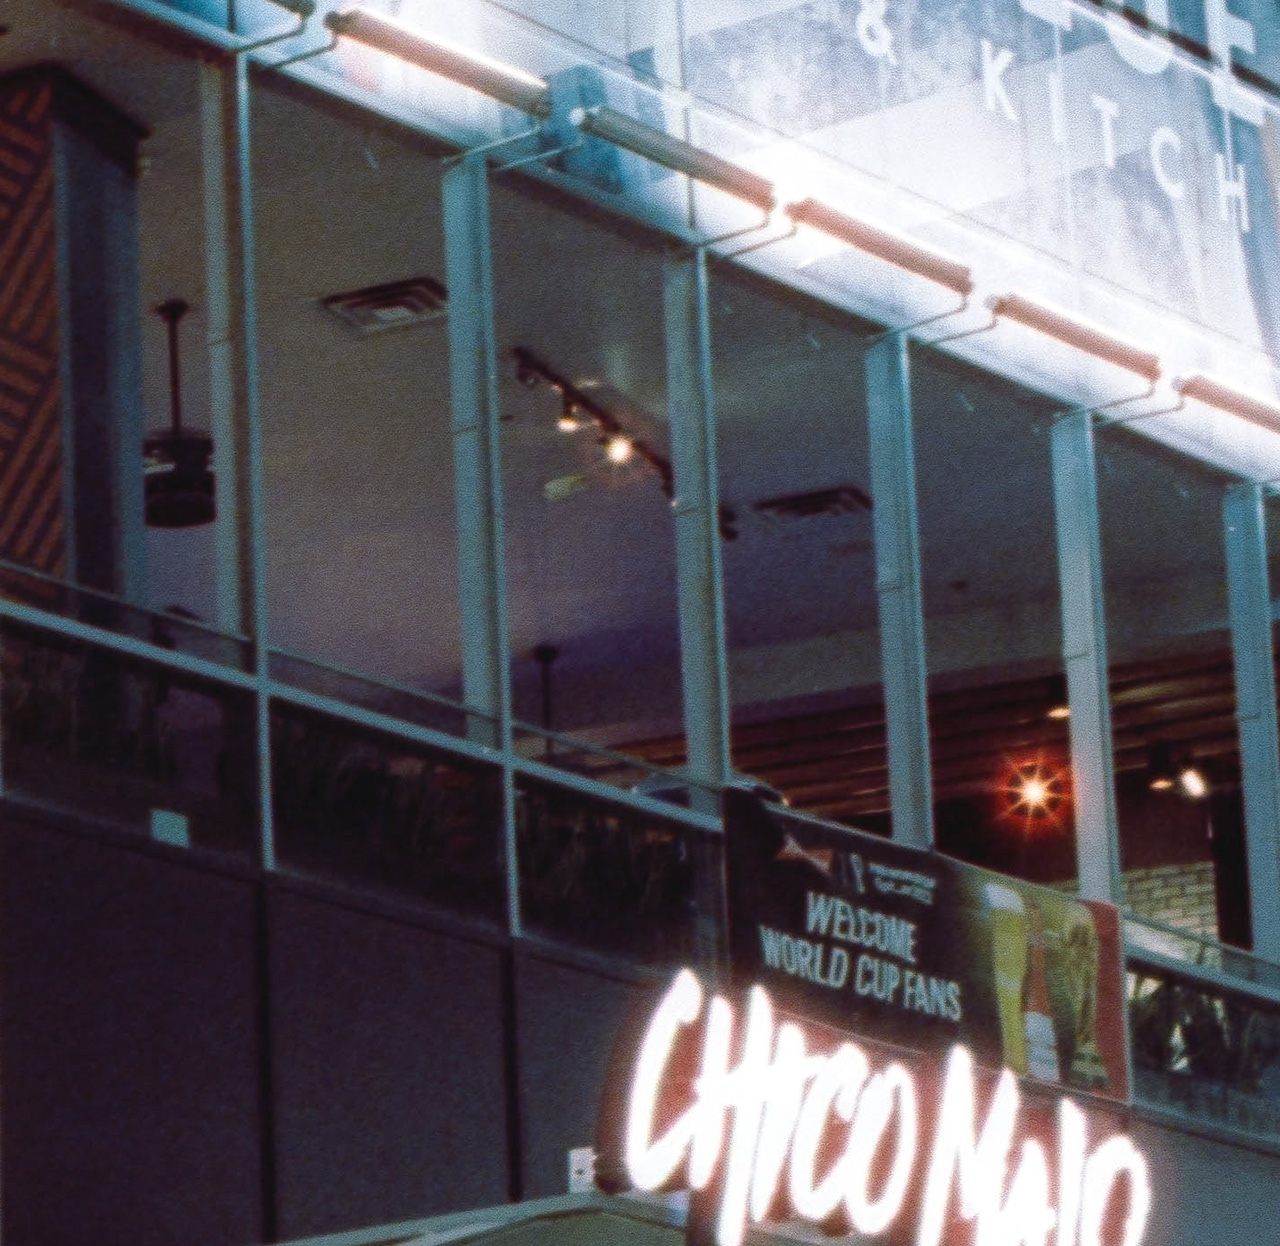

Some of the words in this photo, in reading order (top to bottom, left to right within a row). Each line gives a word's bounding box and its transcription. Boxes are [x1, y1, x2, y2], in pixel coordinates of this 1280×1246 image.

[806, 890, 918, 965] WELCOME
[758, 923, 848, 990] WORLD
[855, 953, 901, 1004] CUP
[904, 968, 963, 1022] FANS
